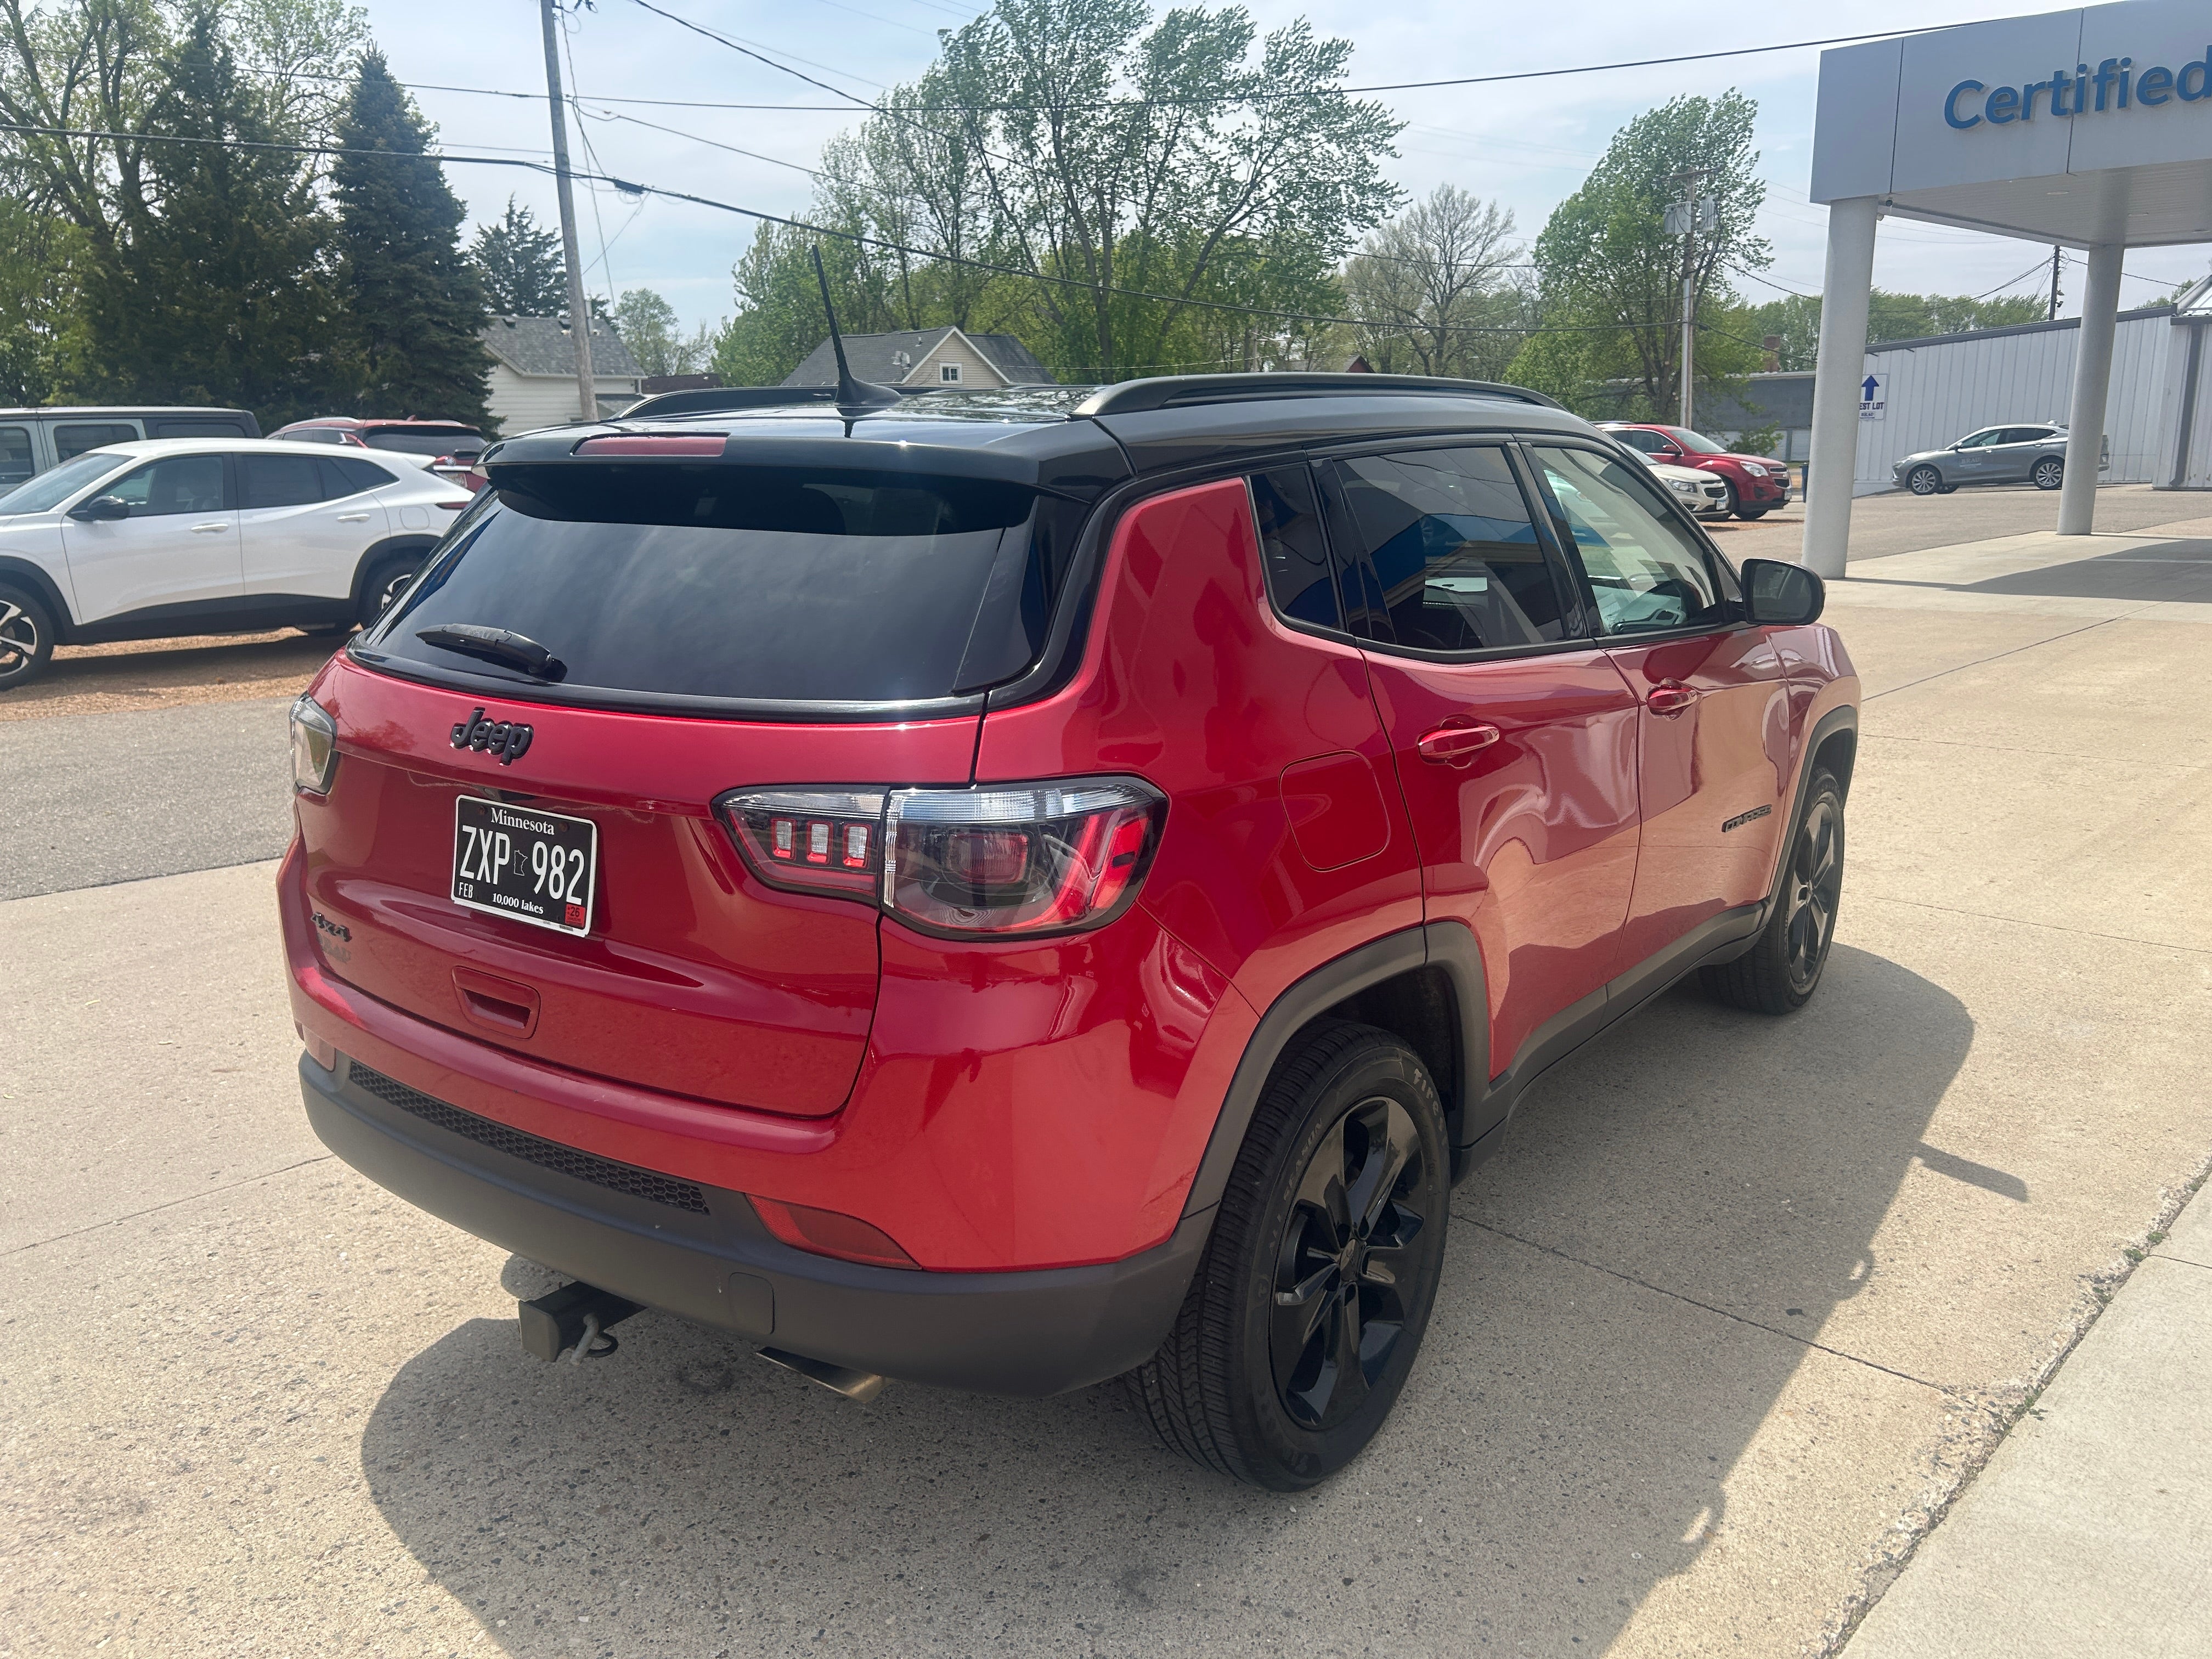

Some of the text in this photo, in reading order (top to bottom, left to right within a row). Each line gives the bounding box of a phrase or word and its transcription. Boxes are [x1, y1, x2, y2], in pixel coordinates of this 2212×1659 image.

[1944, 45, 2212, 129] Certified
[1872, 402, 1884, 410] LOT
[450, 706, 534, 766] Jeep
[491, 807, 555, 836] Minnesota
[460, 825, 584, 905] ZXP 982
[459, 882, 473, 898] FEB
[521, 899, 544, 915] lakes
[570, 906, 580, 917] 26
